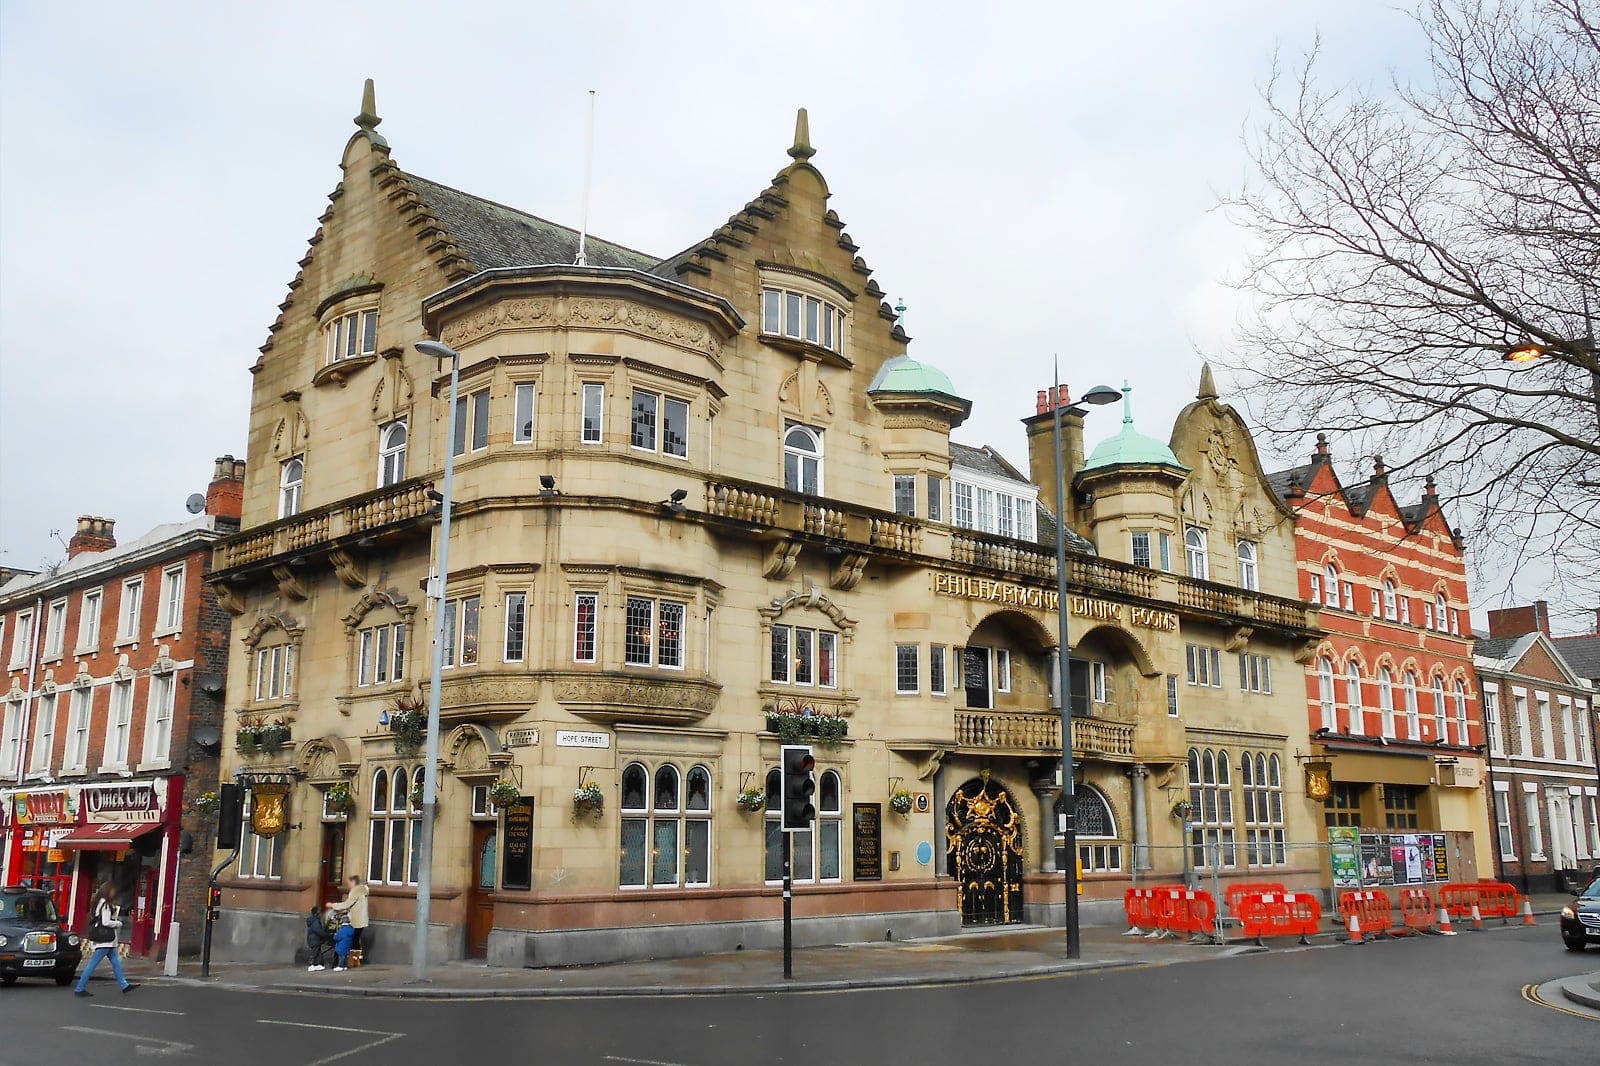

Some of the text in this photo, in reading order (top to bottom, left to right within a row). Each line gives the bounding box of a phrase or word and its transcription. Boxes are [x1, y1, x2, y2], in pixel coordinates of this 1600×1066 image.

[1072, 597, 1122, 620] DINING
[1131, 607, 1178, 630] ROOMS
[511, 737, 533, 745] STREET
[562, 735, 603, 744] HOPE STREET
[89, 786, 152, 812] Quick Chef
